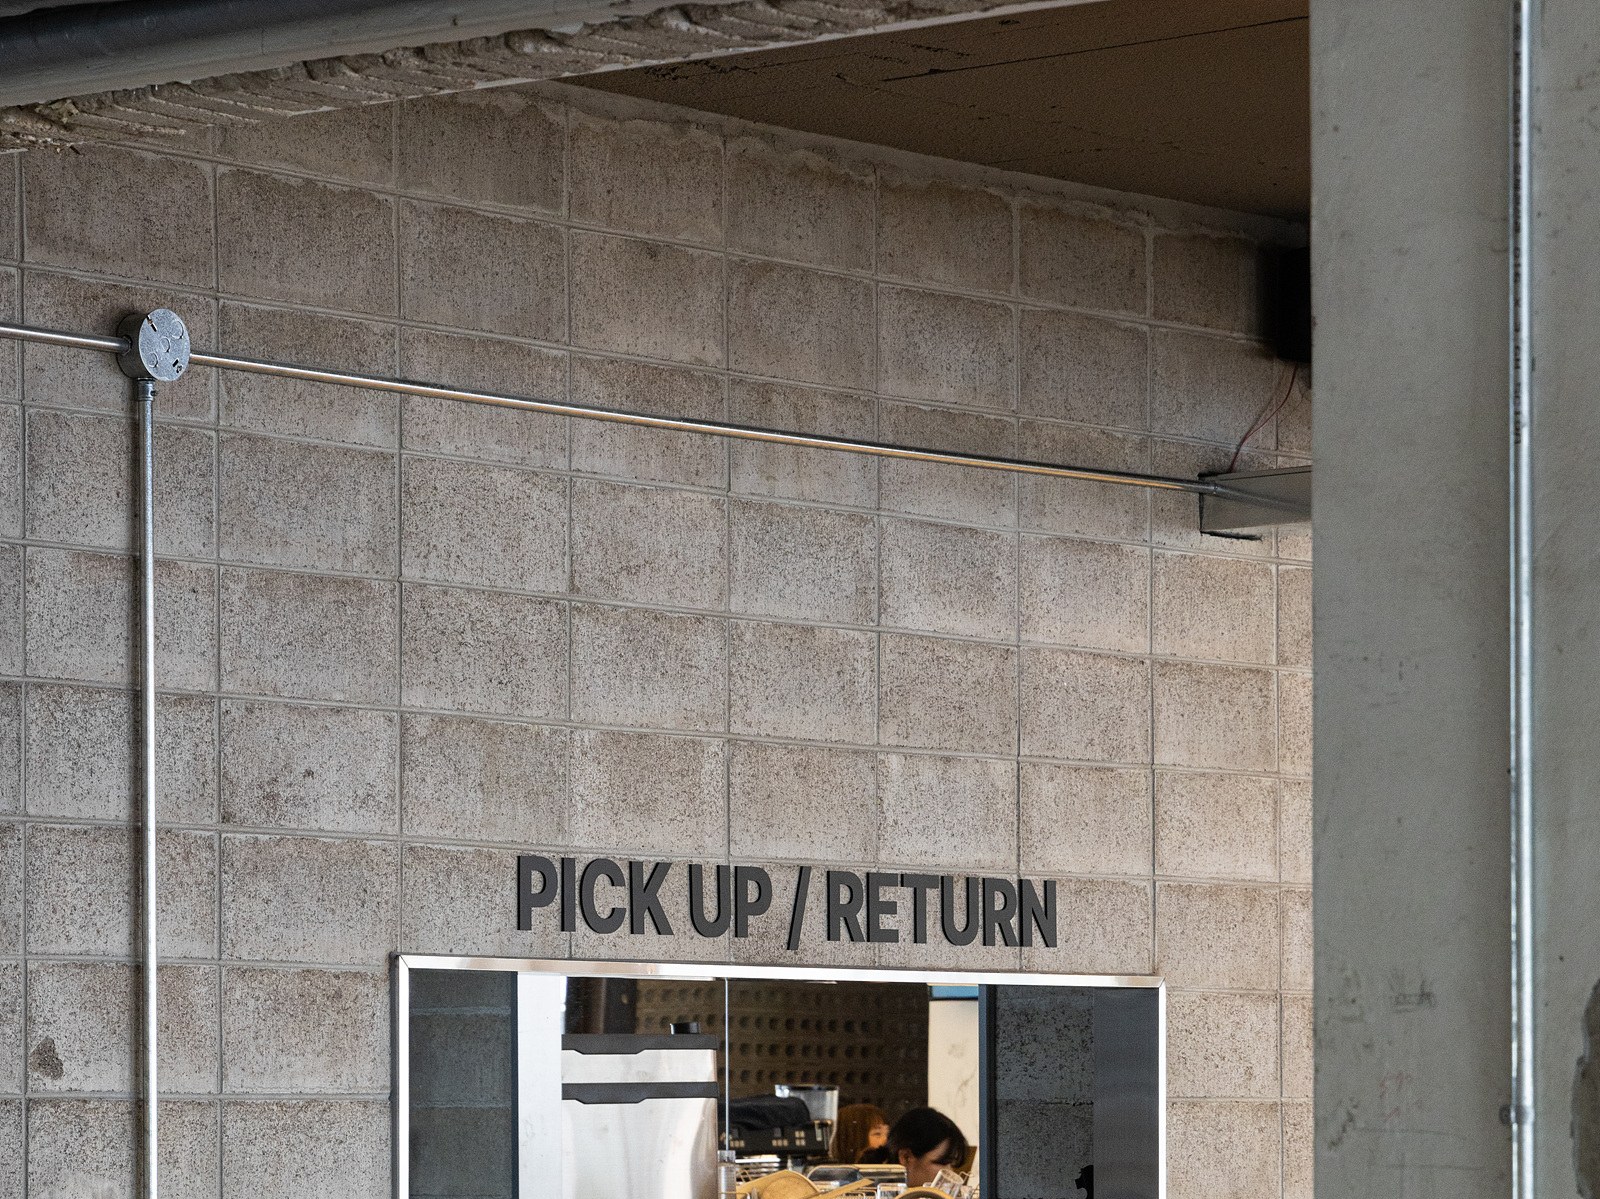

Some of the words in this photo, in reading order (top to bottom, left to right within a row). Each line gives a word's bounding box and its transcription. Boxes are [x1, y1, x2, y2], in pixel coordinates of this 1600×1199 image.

[516, 855, 674, 935] PICK
[688, 862, 773, 938] UP
[786, 866, 812, 951] /
[826, 870, 1058, 948] RETURN
